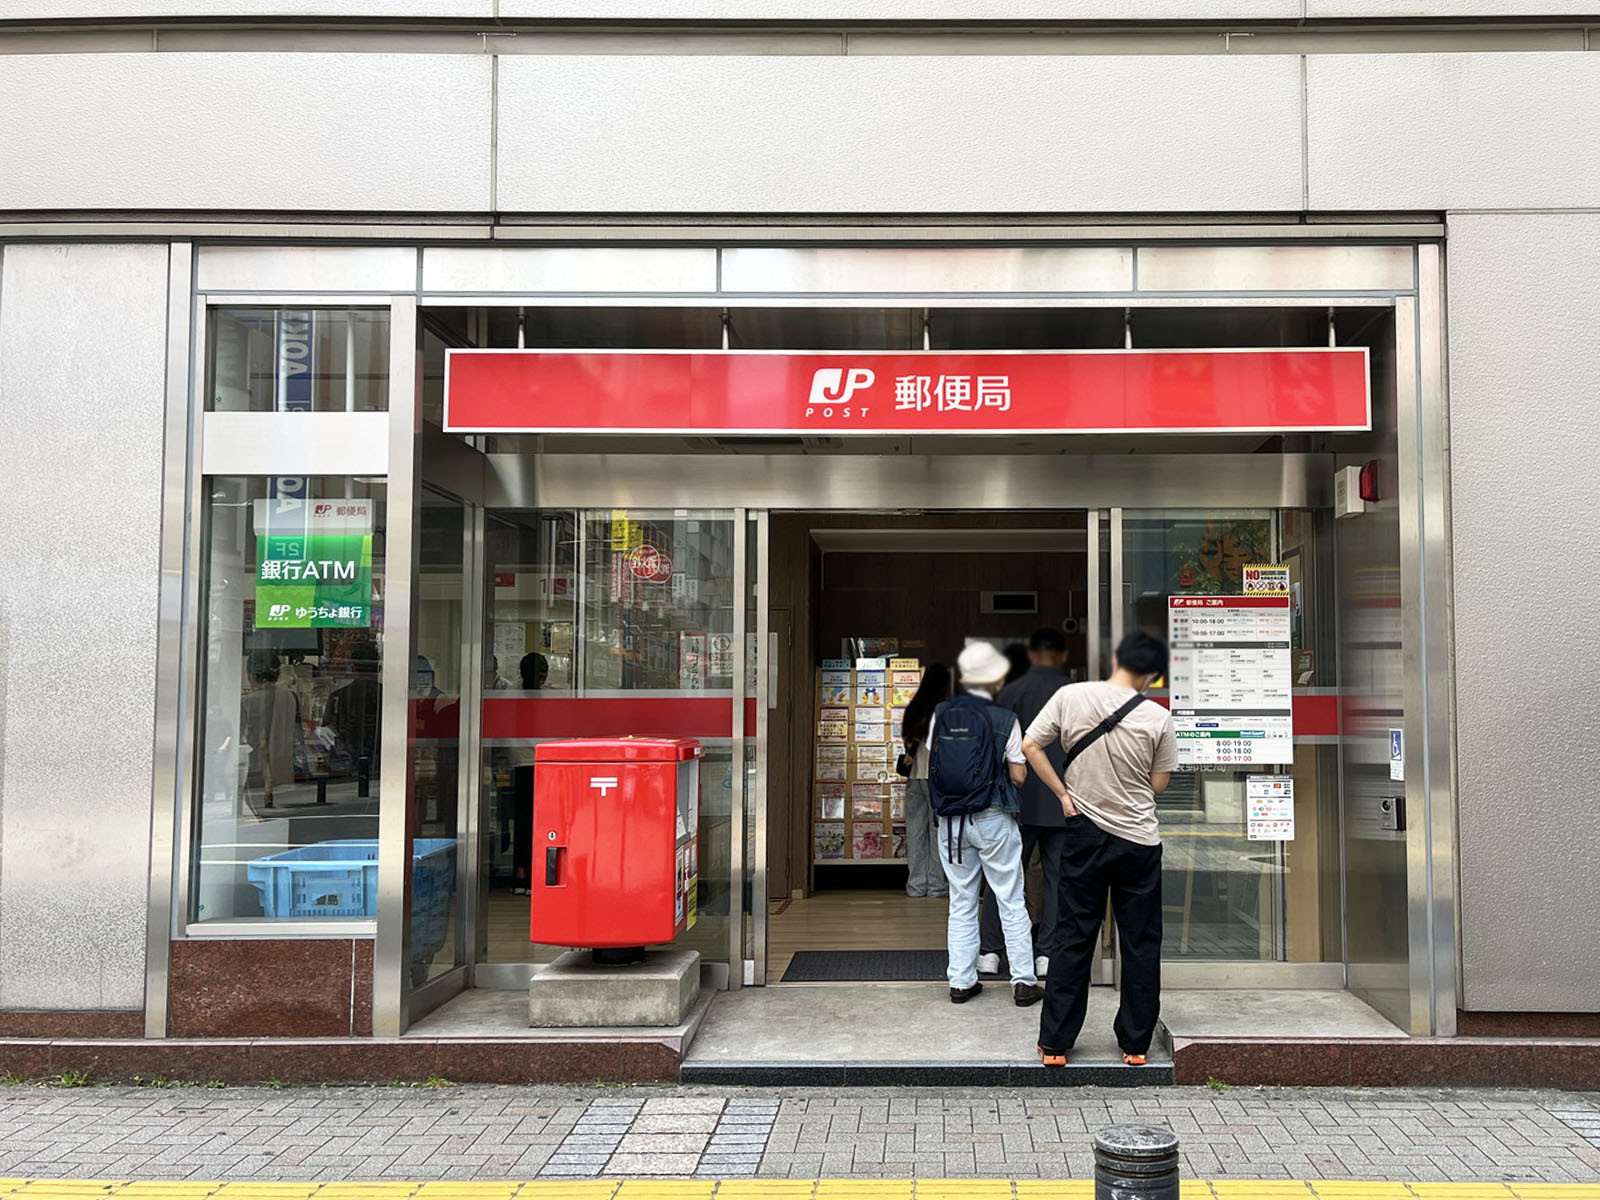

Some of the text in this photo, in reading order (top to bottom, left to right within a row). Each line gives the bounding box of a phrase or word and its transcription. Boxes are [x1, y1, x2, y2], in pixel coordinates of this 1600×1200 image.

[808, 368, 1012, 412] JP 郵便局
[804, 407, 870, 418] POST
[336, 505, 367, 516] 郵便局
[260, 559, 355, 580] 銀行ATM
[1245, 569, 1260, 580] NO
[269, 604, 363, 619] JP ゆうちょ銀行
